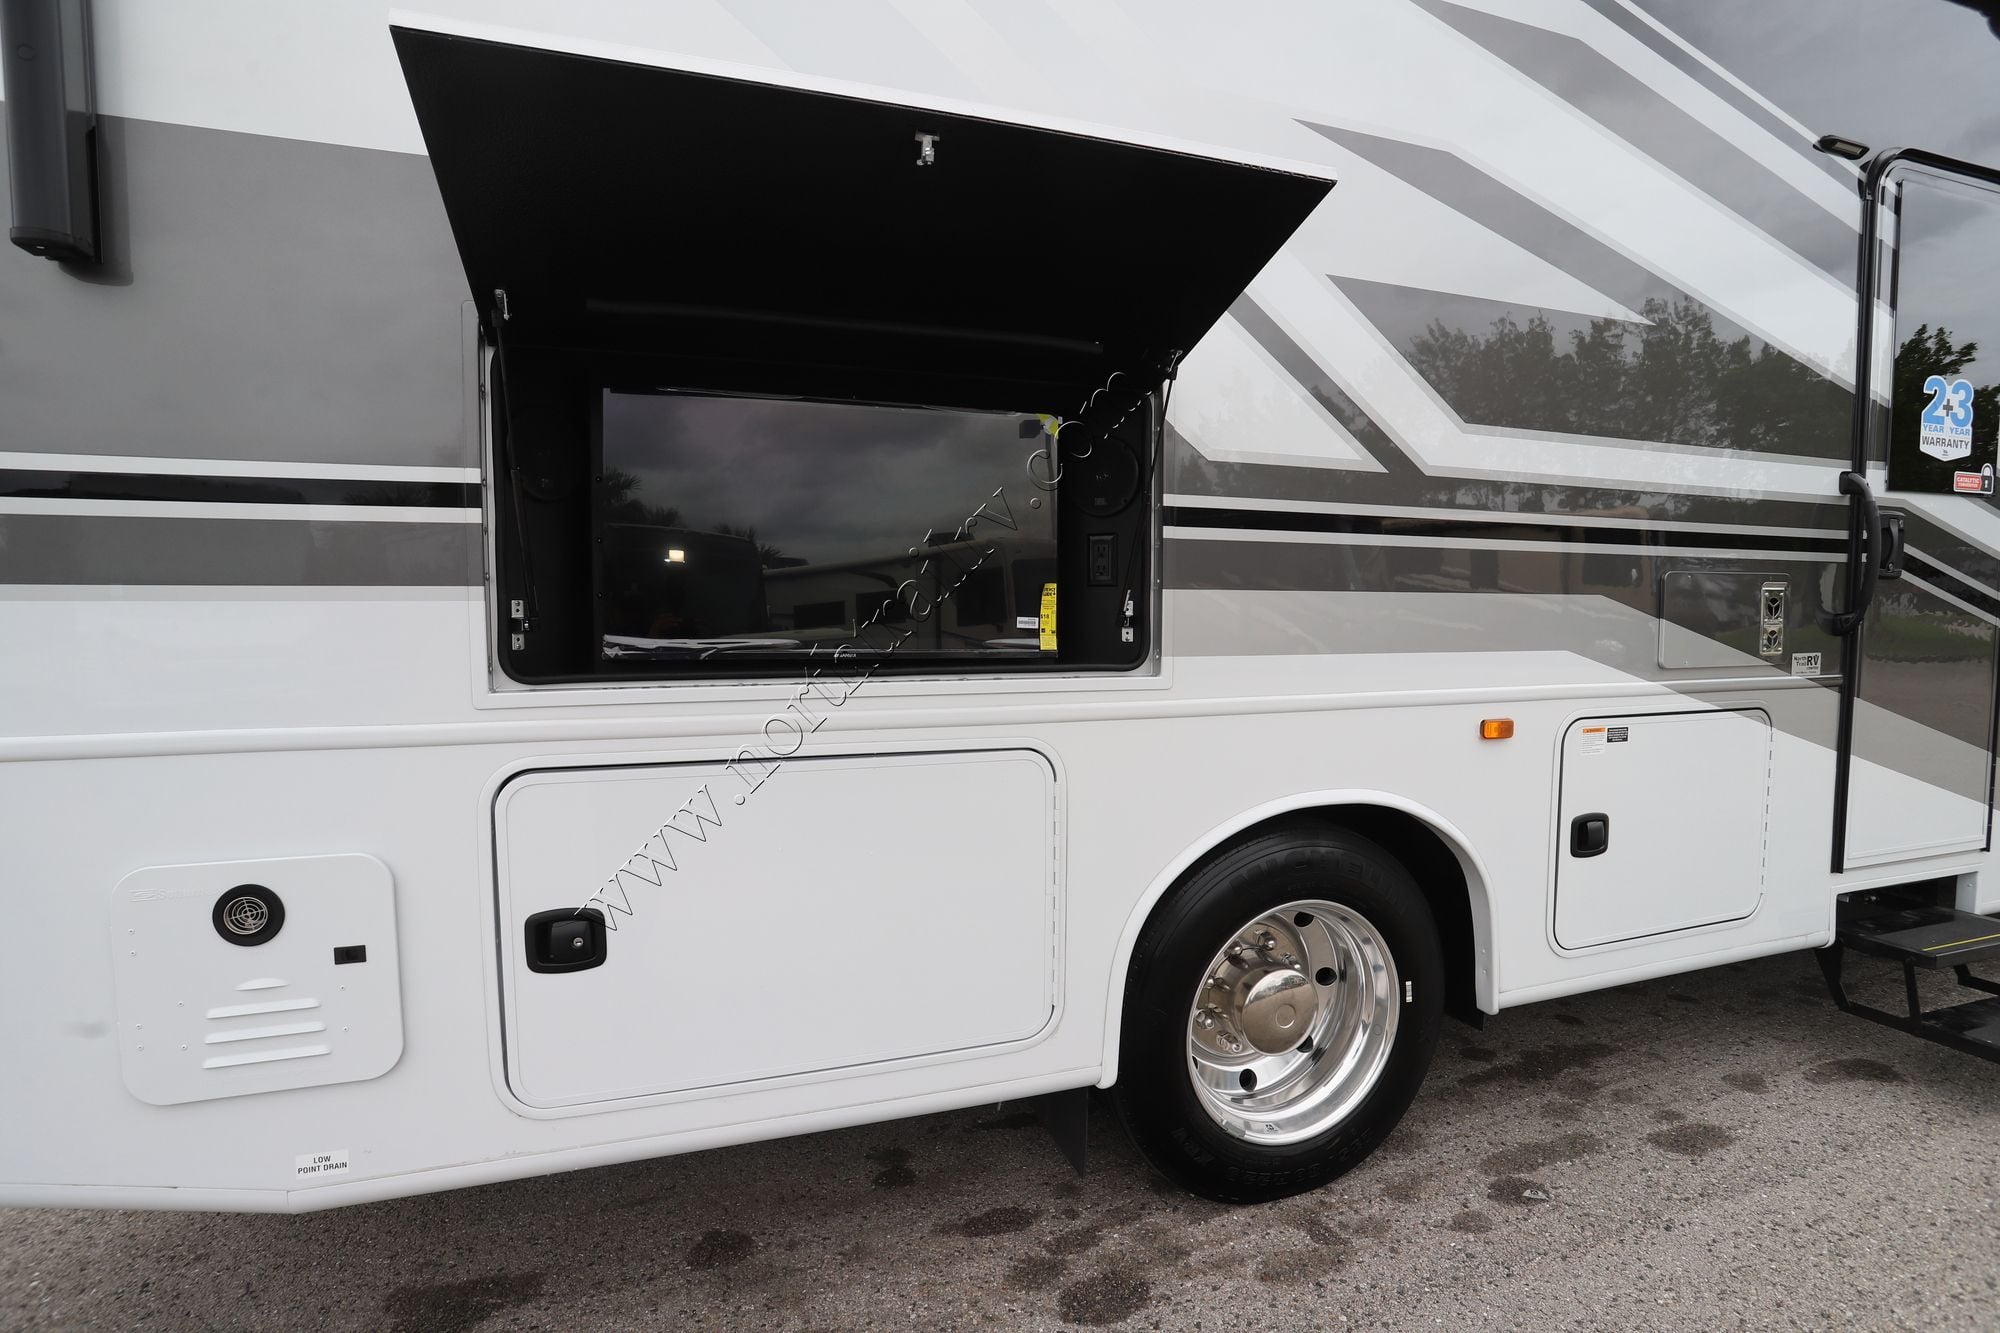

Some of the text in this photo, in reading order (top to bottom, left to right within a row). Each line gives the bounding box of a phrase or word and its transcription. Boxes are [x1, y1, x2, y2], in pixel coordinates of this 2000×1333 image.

[1923, 424, 1970, 436] YEAR YEAR
[1922, 436, 1970, 449] WARRANTY
[1807, 654, 1820, 666] RV
[313, 1155, 331, 1164] LOW
[297, 1161, 348, 1174] POINT DRAIN
